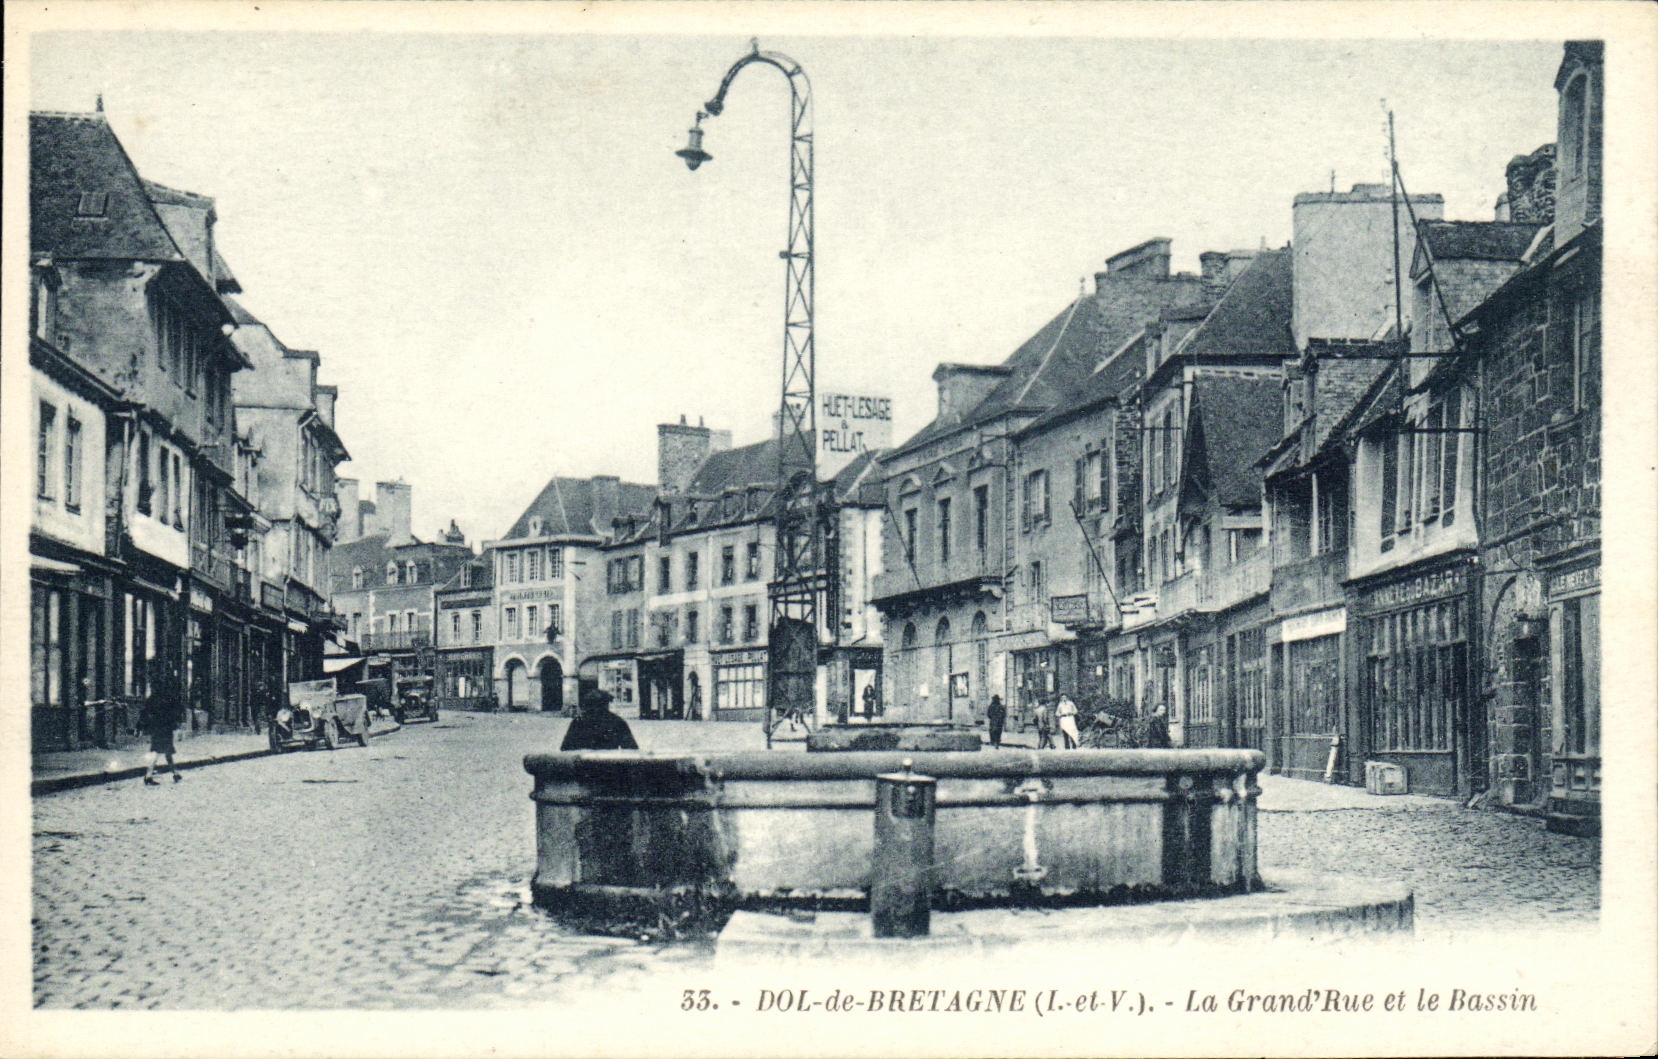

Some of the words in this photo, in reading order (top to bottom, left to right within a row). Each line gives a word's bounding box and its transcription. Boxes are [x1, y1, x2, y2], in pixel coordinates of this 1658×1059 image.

[822, 393, 892, 421] HUET-LESAGE
[841, 419, 849, 430] &
[822, 429, 864, 452] PELLAT
[1415, 570, 1454, 599] BAZAR
